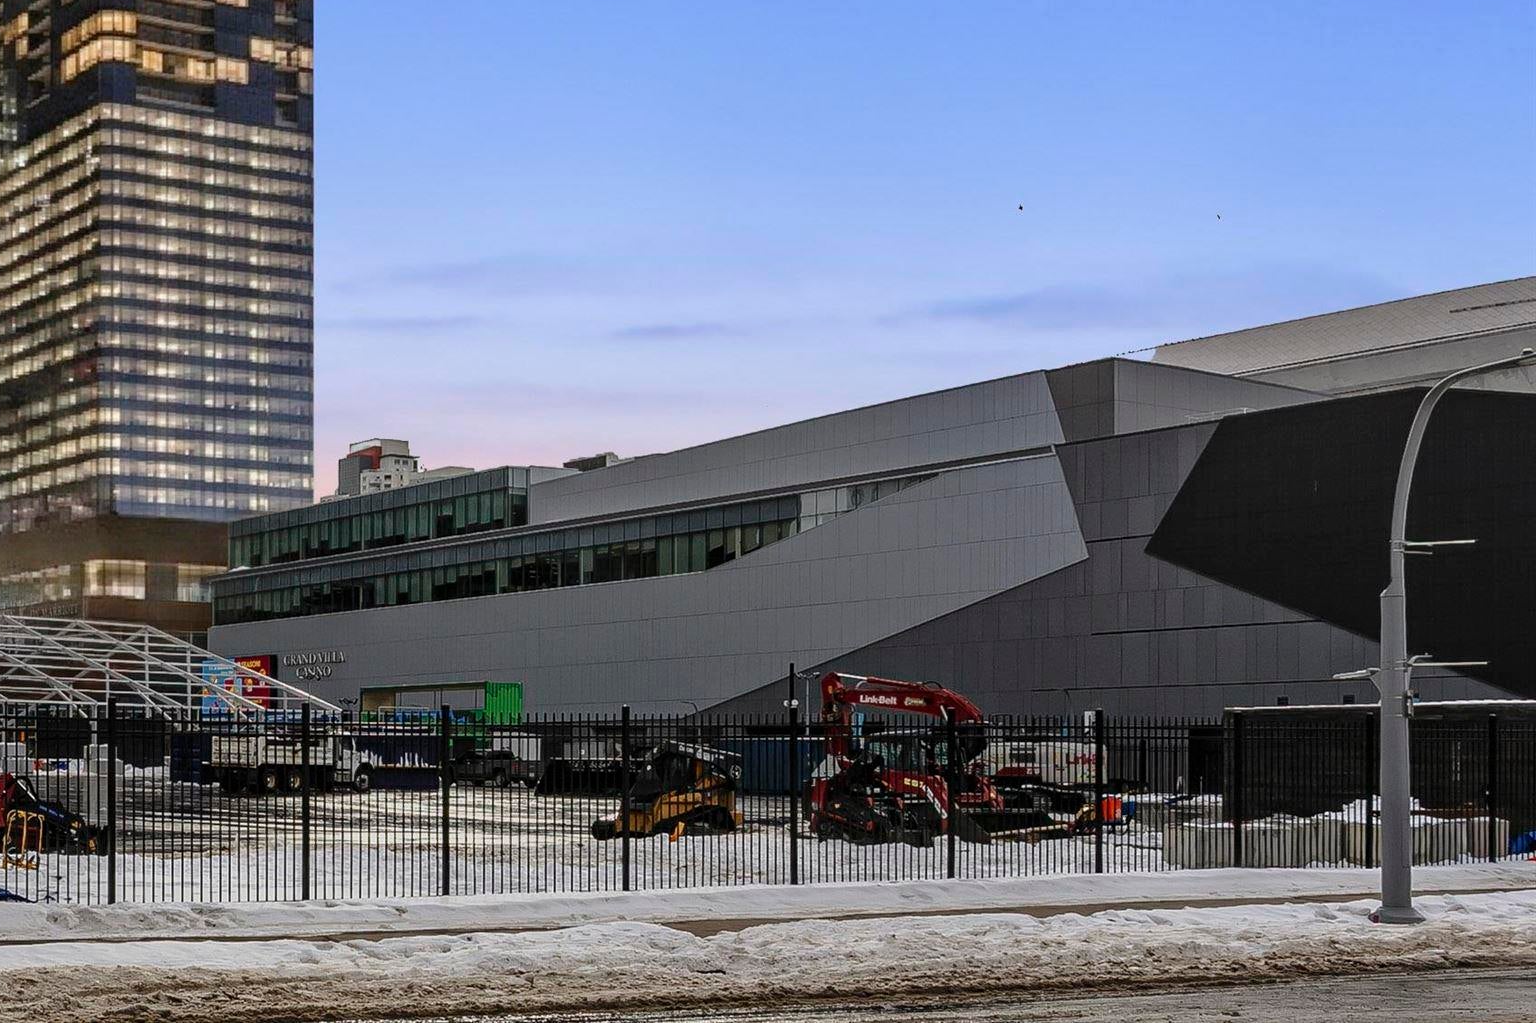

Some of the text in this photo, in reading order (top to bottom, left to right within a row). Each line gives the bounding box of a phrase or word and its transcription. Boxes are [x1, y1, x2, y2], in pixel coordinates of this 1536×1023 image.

[283, 651, 345, 666] GRAND VILLA
[296, 665, 332, 680] CASINO
[859, 694, 897, 705] Link-Belt
